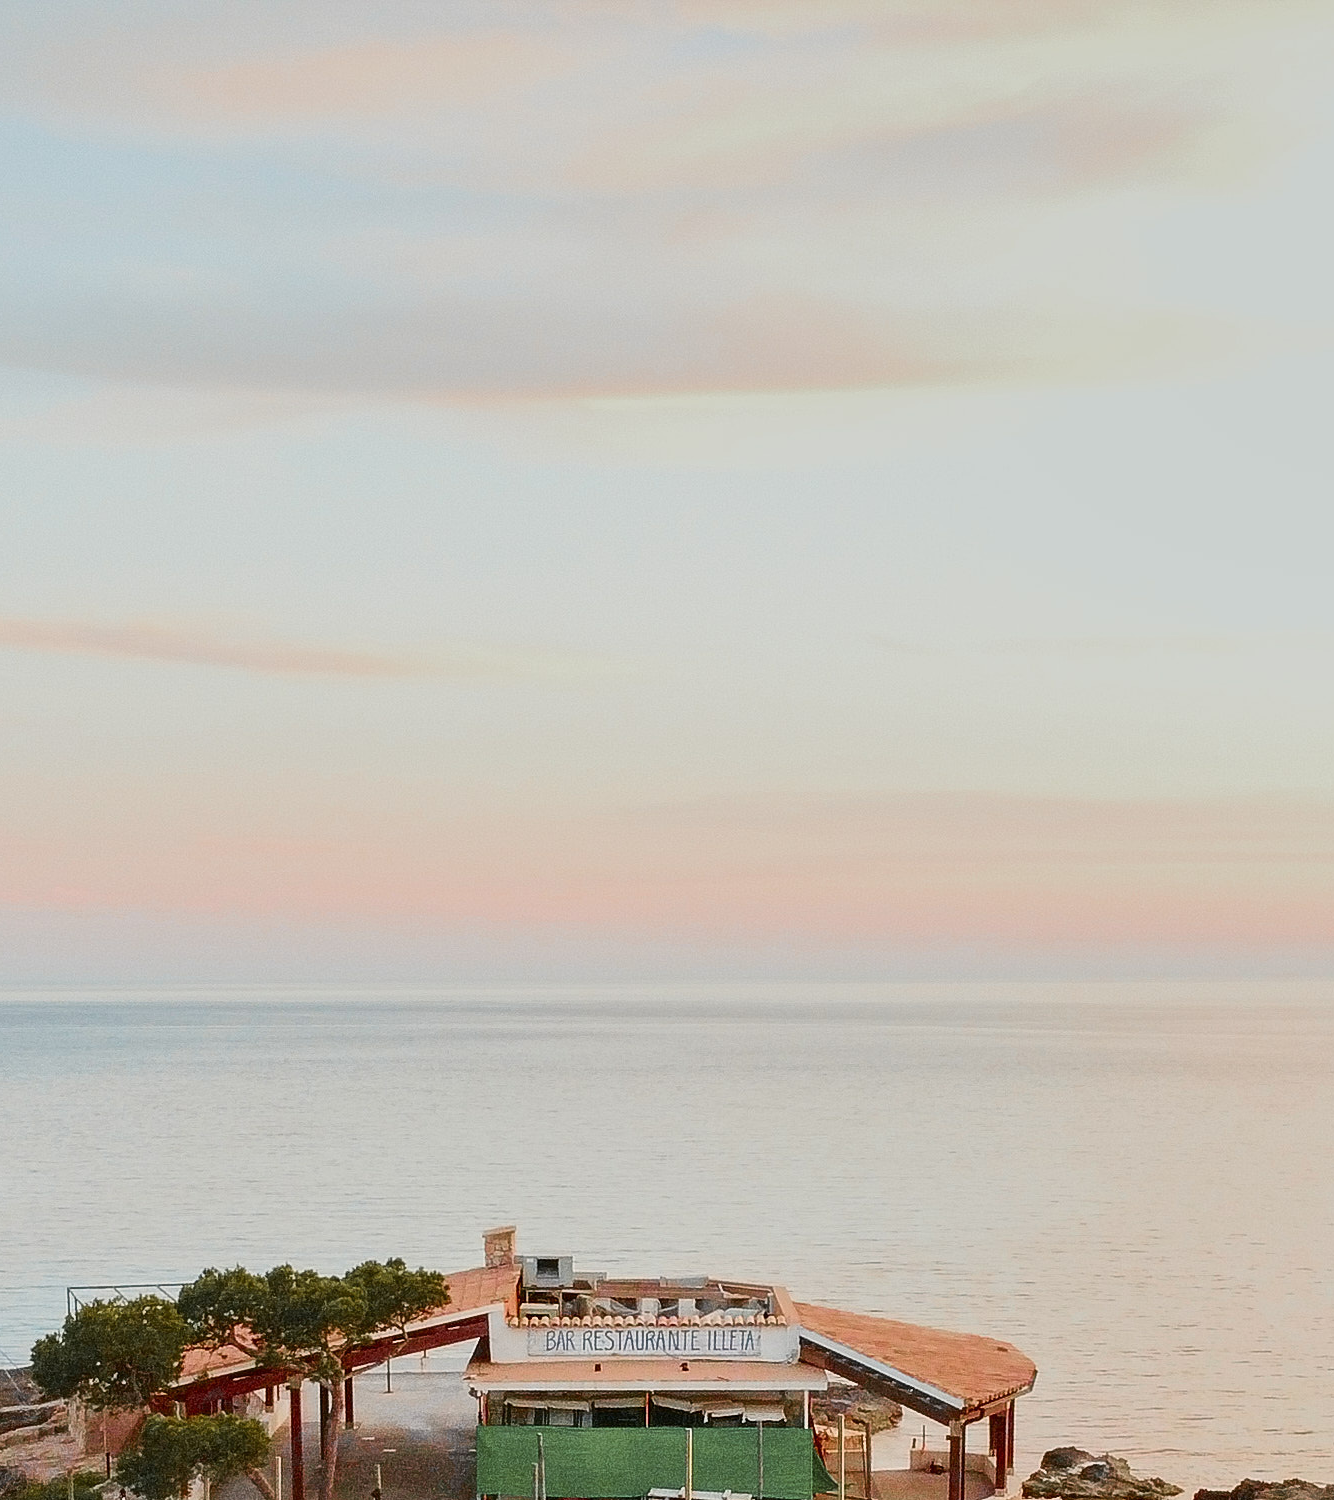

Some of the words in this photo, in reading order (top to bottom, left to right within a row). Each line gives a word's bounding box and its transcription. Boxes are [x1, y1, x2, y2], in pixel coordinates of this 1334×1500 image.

[546, 1330, 575, 1351] BAR
[582, 1330, 700, 1351] RESTAURANTE
[708, 1330, 754, 1351] ILLETA
